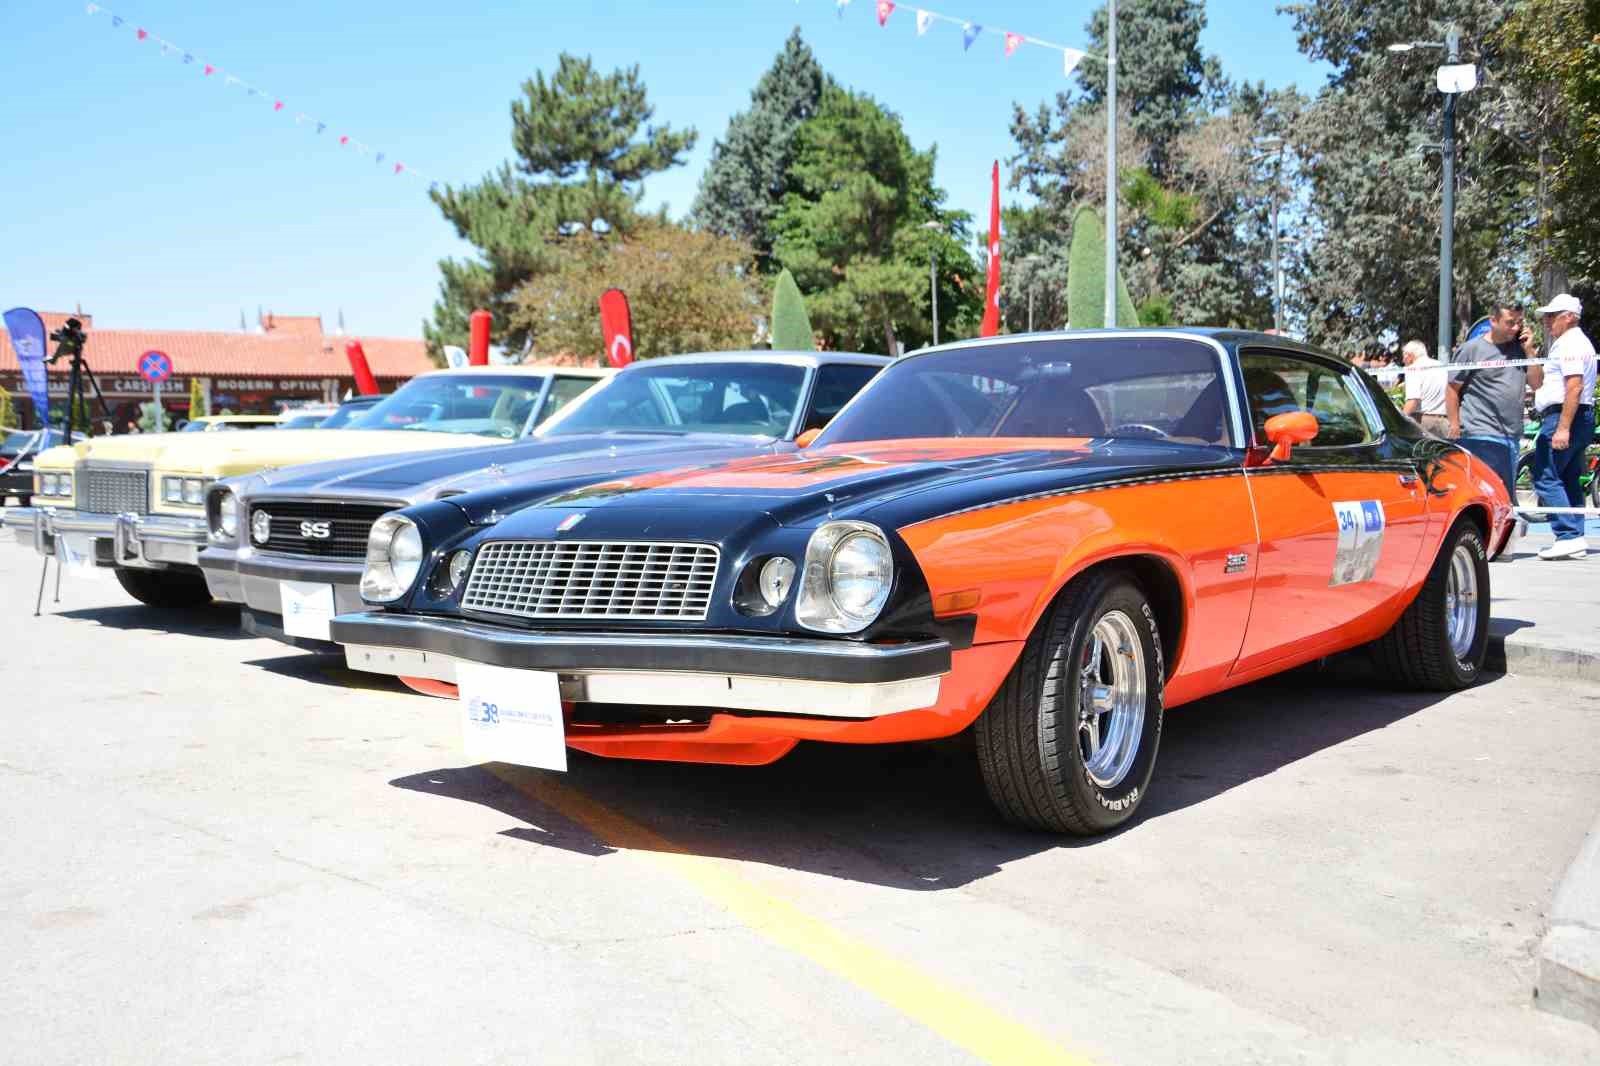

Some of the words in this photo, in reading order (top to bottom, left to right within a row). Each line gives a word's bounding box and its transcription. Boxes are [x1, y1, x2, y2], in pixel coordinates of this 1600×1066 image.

[217, 380, 273, 391] MODERN
[1339, 510, 1354, 531] 34
[300, 521, 330, 539] SS
